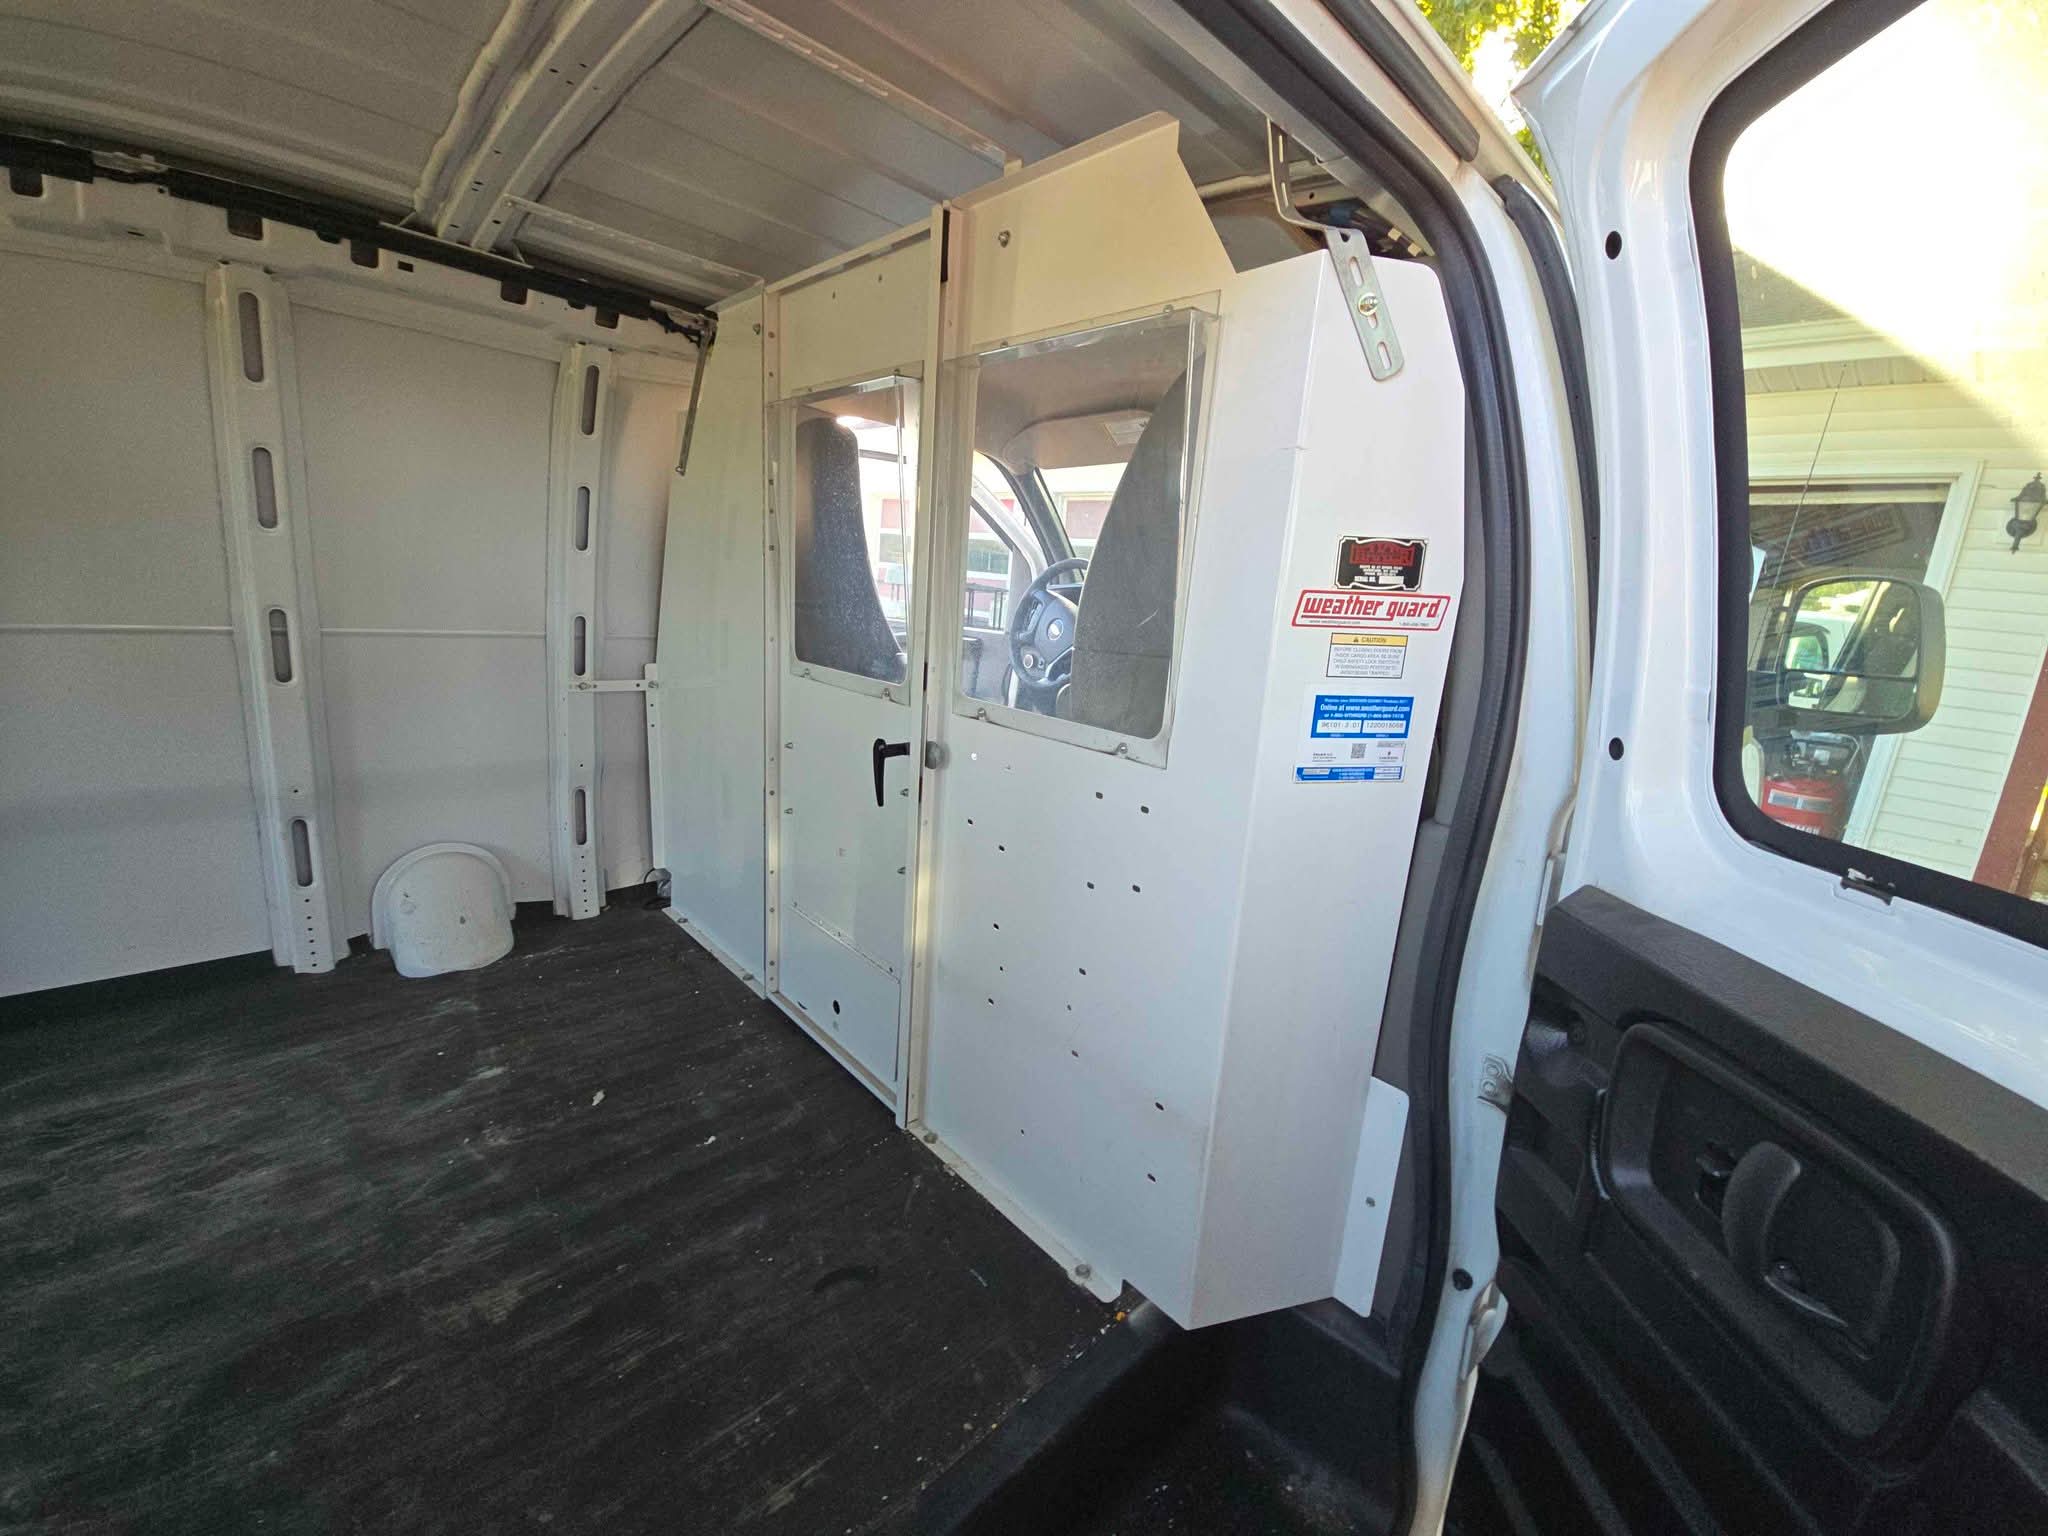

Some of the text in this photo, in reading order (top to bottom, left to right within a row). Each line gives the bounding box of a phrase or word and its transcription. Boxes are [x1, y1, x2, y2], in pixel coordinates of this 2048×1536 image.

[1303, 596, 1441, 621] weather guard
[1345, 705, 1410, 713] www.weatherguard.com
